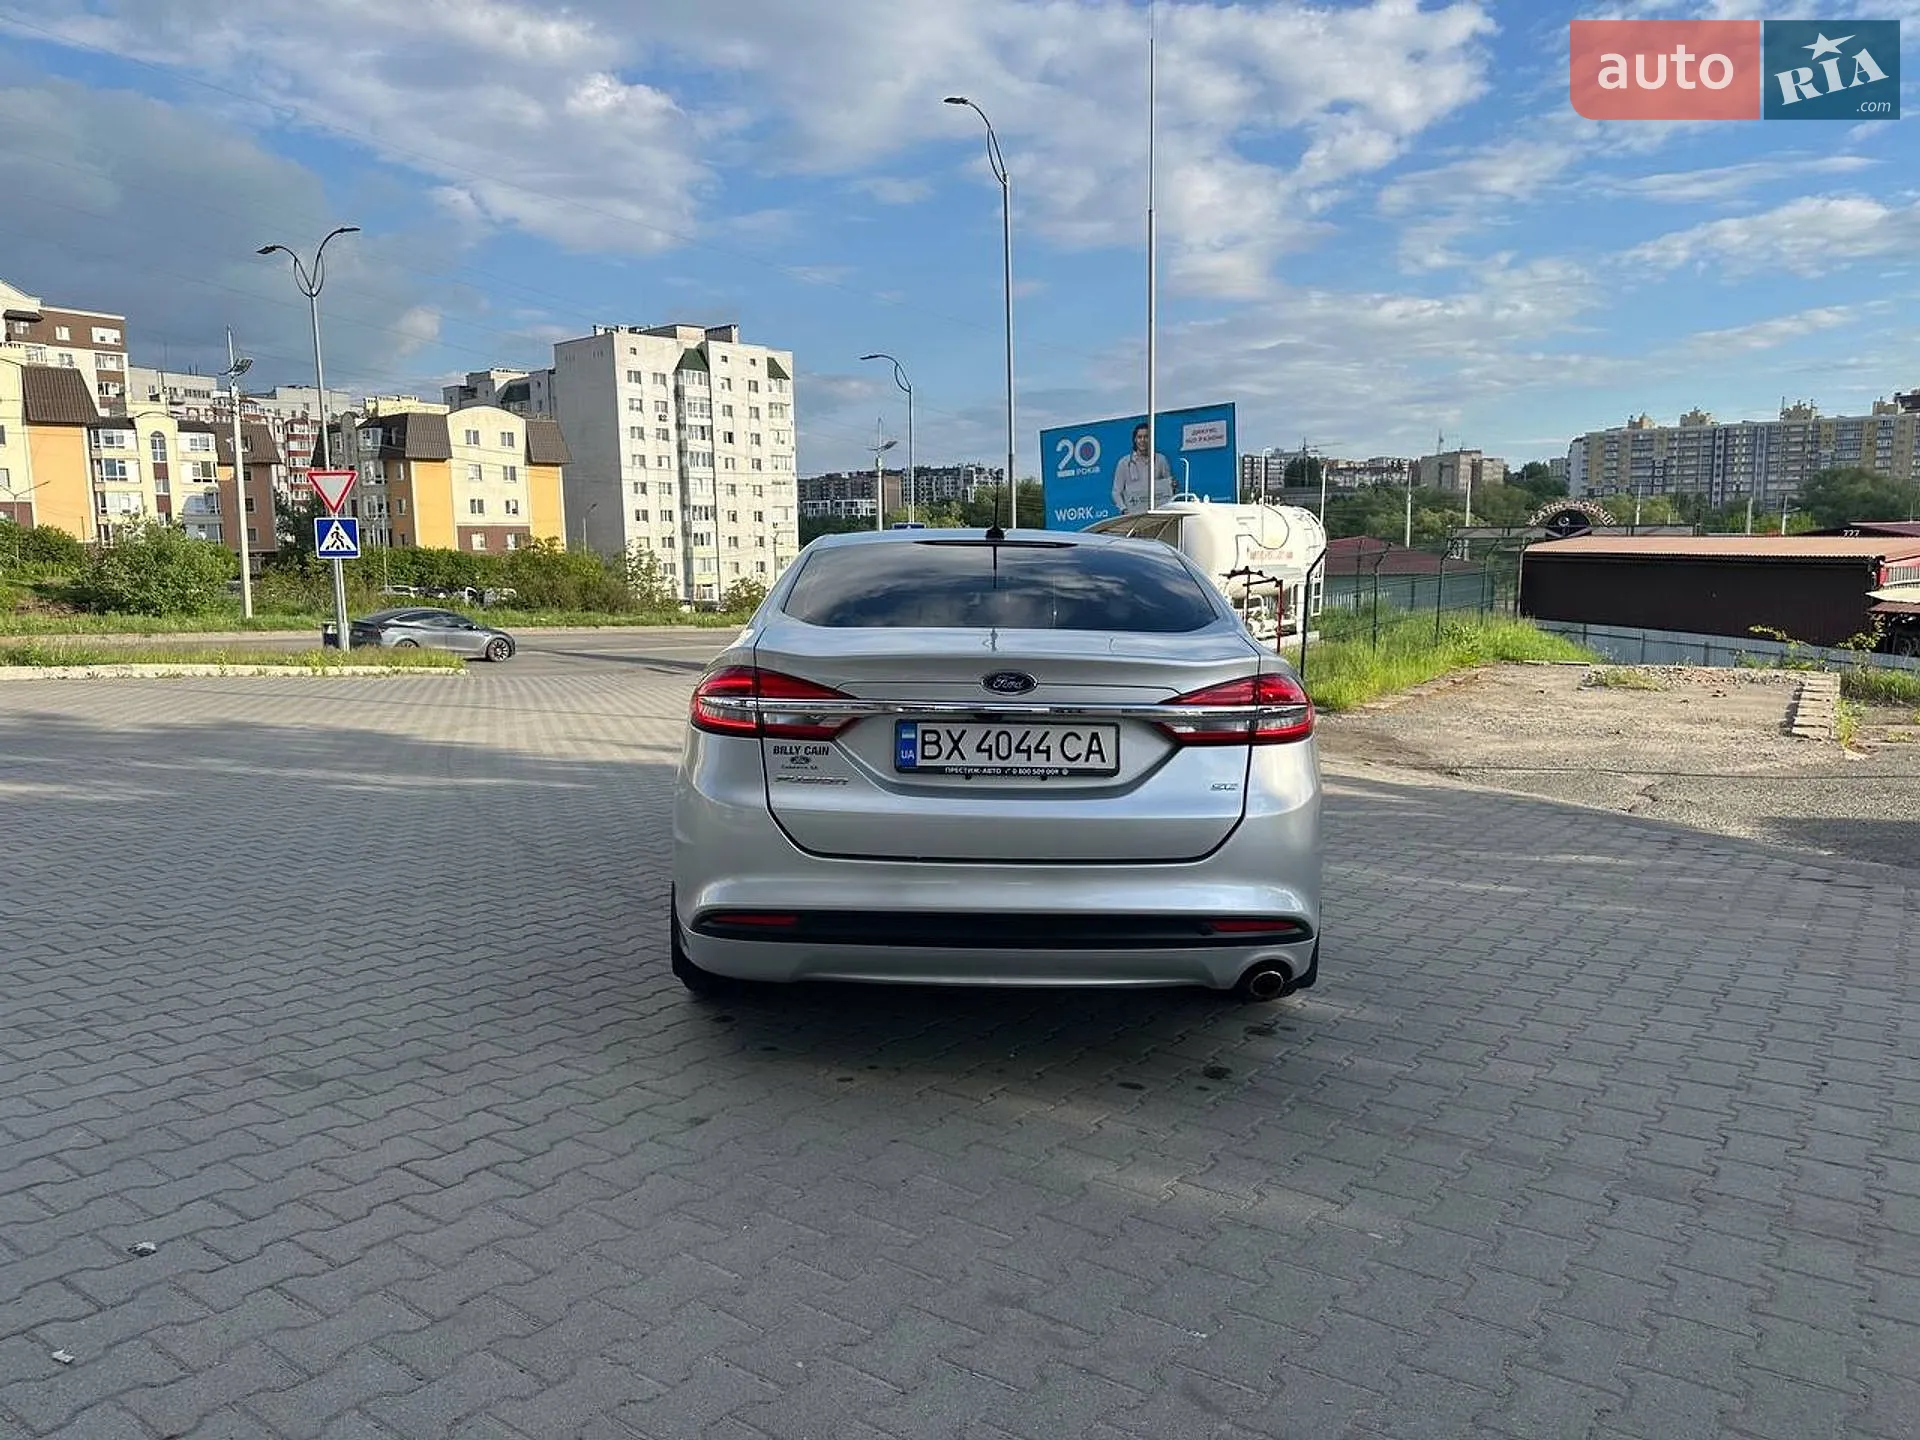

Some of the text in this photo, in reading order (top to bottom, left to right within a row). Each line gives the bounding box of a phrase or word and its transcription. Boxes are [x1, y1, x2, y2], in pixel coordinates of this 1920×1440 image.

[1056, 435, 1101, 477] 20
[773, 745, 830, 756] BILLY CAIN
[901, 750, 916, 760] UA
[920, 729, 1108, 763] BX 4044 CA
